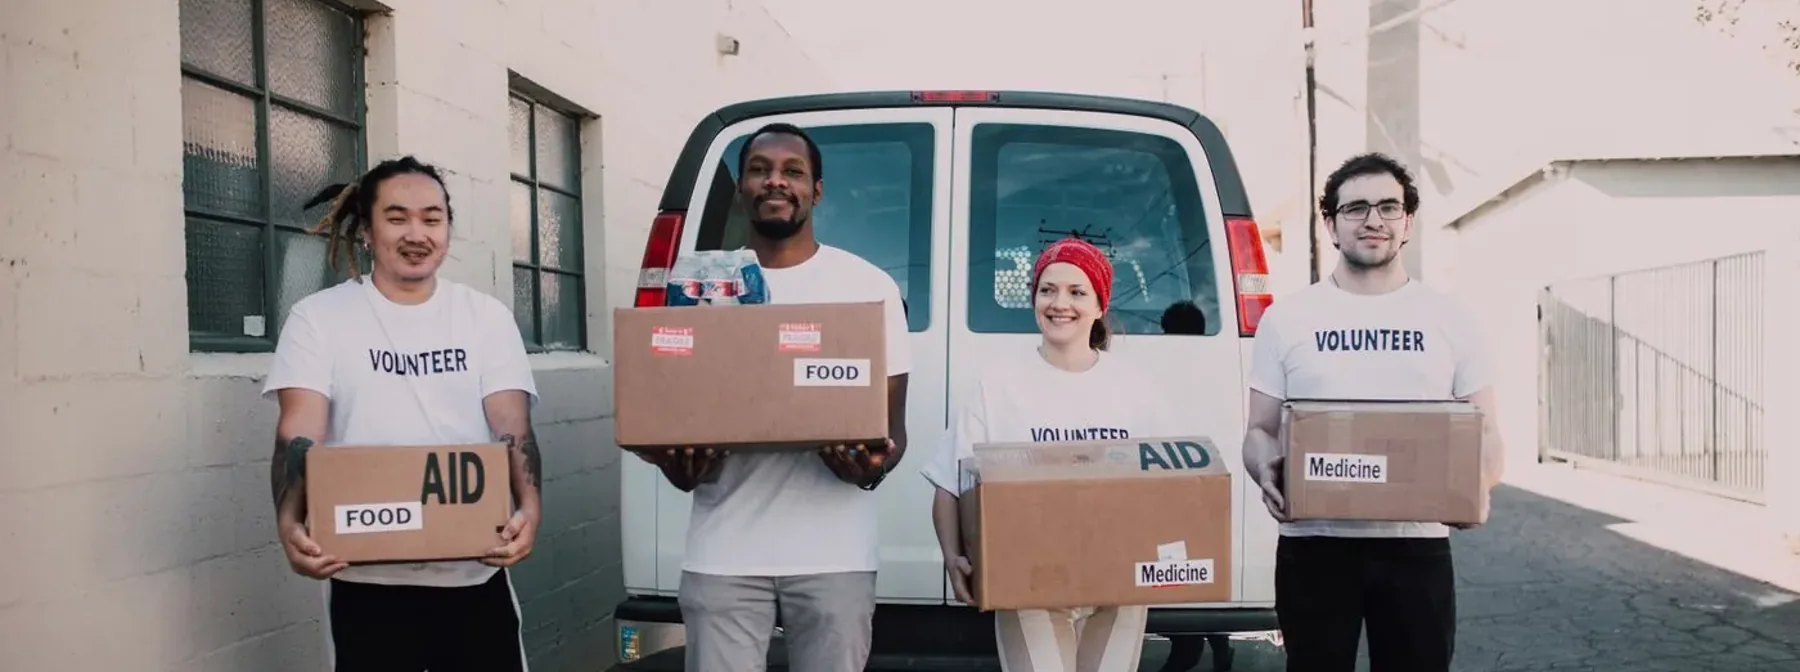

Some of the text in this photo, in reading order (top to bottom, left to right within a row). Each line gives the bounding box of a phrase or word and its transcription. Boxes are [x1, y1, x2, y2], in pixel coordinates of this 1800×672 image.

[1315, 329, 1425, 352] VOLUNTEER
[369, 349, 468, 376] VOLUNTEER
[806, 362, 859, 378] FOOD
[1139, 441, 1210, 471] AID
[421, 451, 485, 505] AID
[1309, 457, 1381, 480] Medicine
[346, 508, 412, 527] FOOD
[1142, 564, 1208, 583] Medicine
